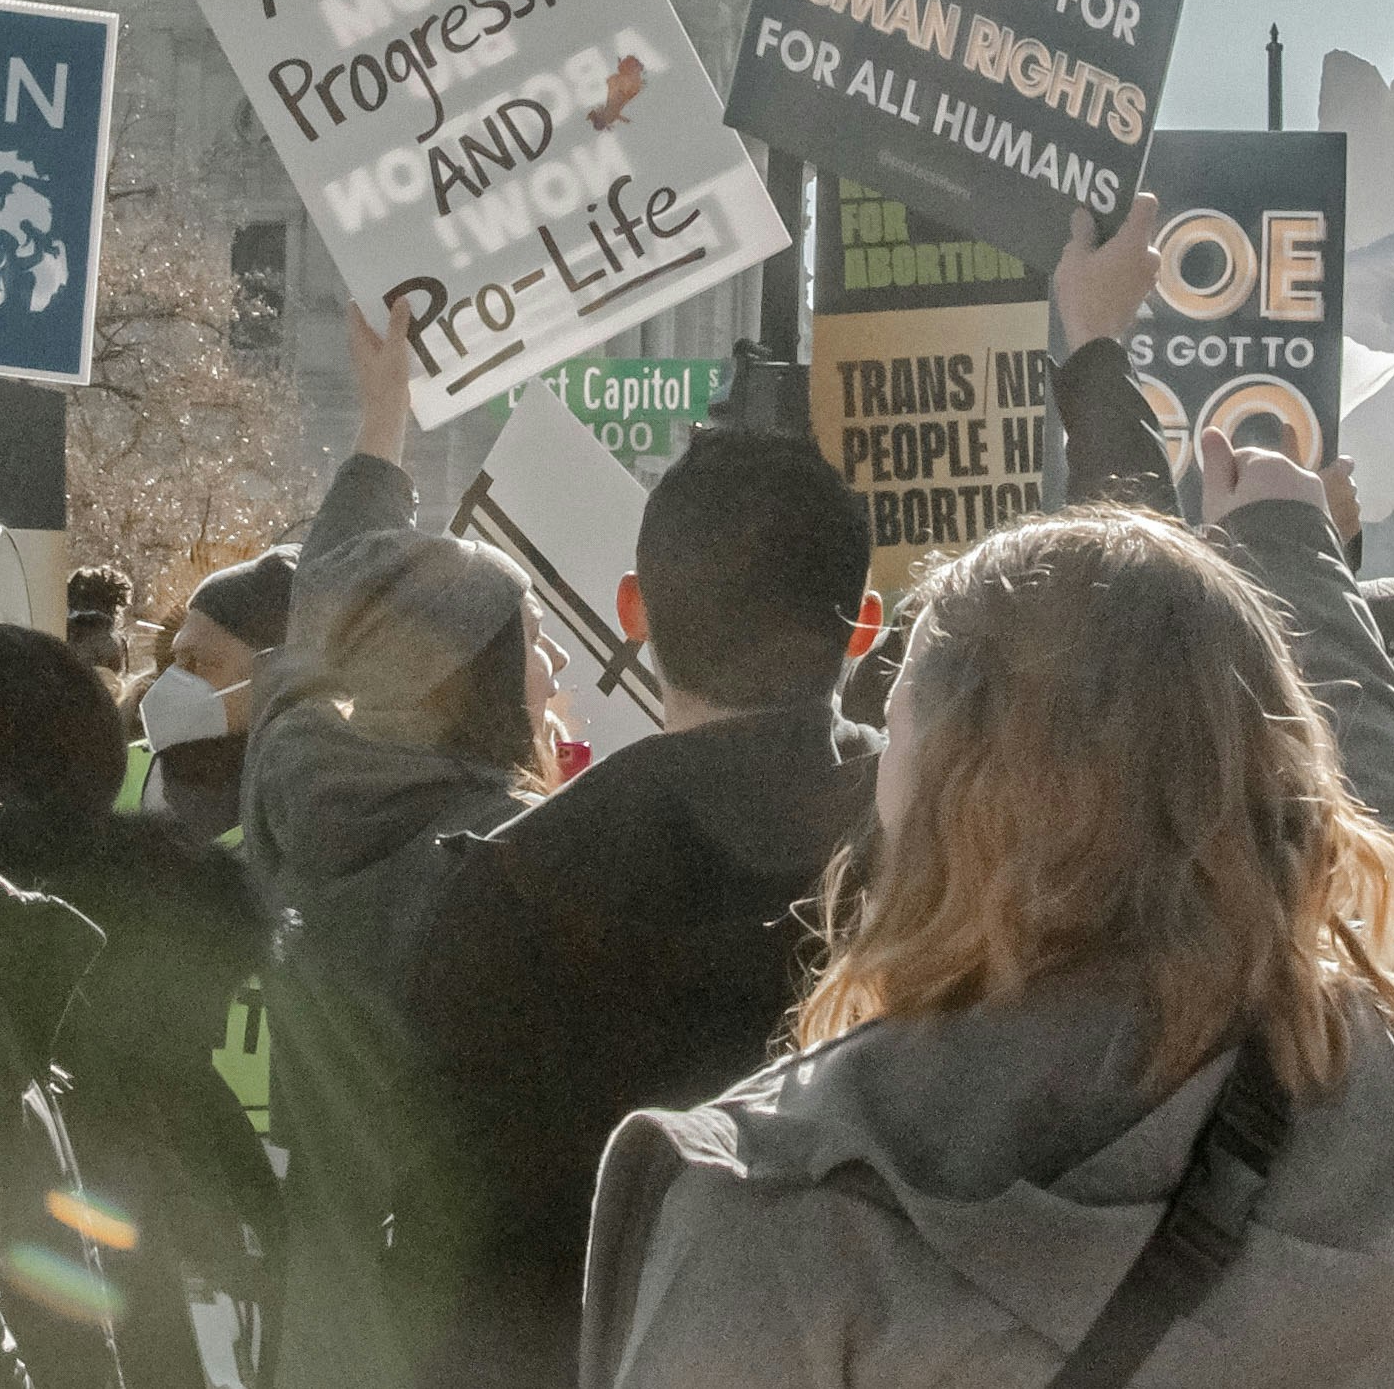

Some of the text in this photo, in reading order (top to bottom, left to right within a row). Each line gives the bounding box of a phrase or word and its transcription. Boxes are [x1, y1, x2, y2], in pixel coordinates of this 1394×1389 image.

[755, 17, 843, 87] FOR
[846, 59, 922, 125] ALL
[932, 94, 1121, 215] HUMANS
[963, 13, 1147, 146] RIGHTS
[427, 97, 552, 217] AND
[382, 174, 701, 378] Pro-Life
[1136, 208, 1327, 321] OE
[583, 366, 691, 420] Capitol
[1166, 335, 1253, 368] GOT
[1262, 337, 1315, 369] TO
[589, 421, 653, 451] 00
[841, 418, 989, 483] PEOPLE
[855, 482, 1043, 547] BORTION
